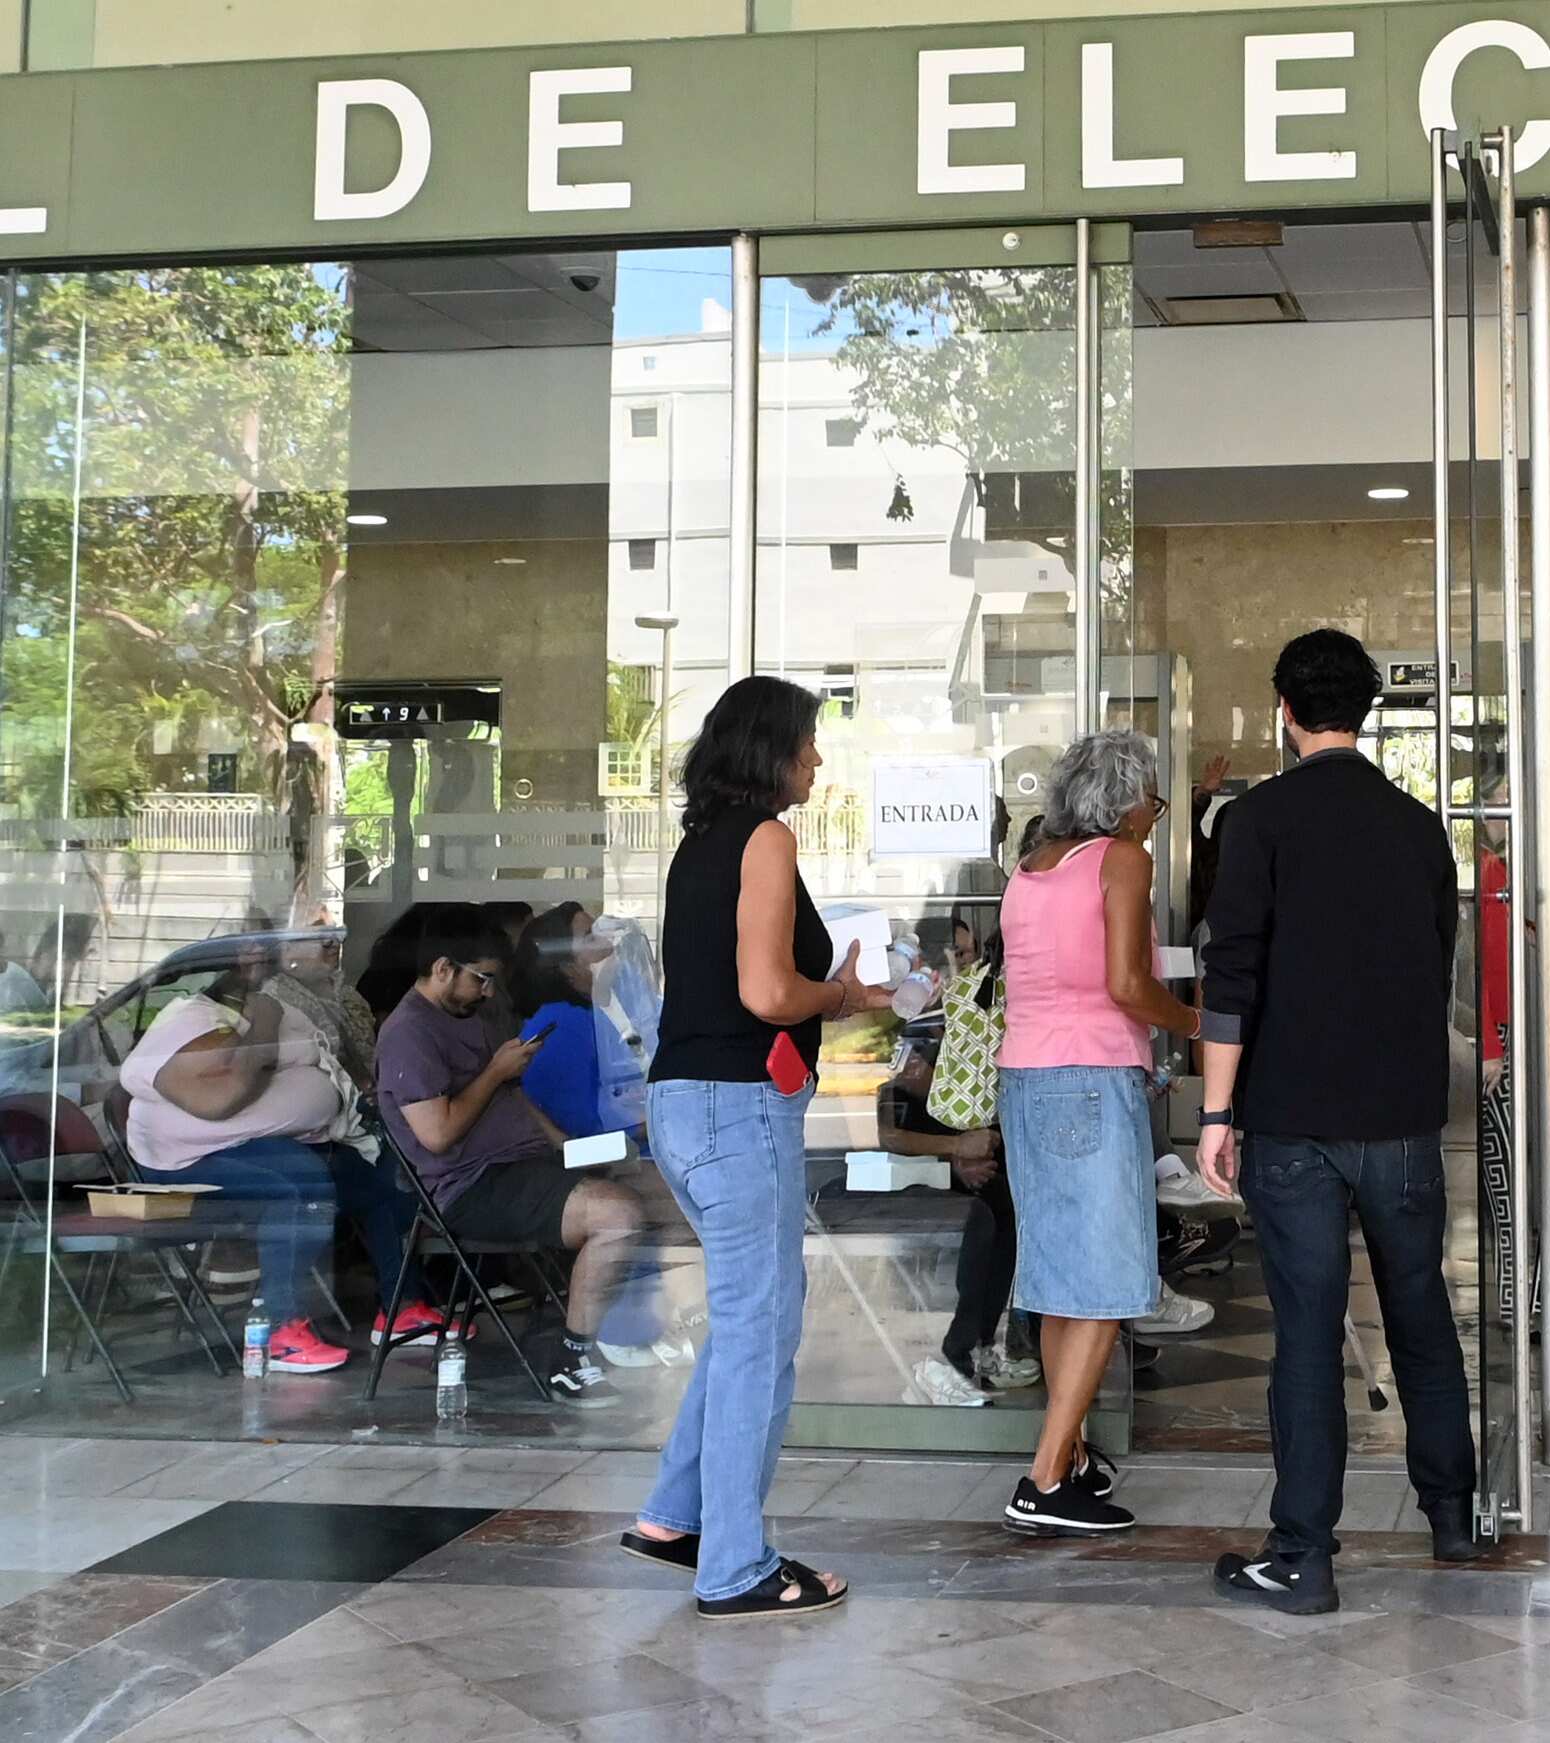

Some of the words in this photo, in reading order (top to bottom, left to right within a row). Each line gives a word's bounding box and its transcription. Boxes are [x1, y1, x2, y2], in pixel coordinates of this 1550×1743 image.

[314, 66, 632, 221] DE
[399, 707, 409, 721] 9
[880, 804, 979, 823] ENTRADA
[1017, 1498, 1036, 1511] AIR
